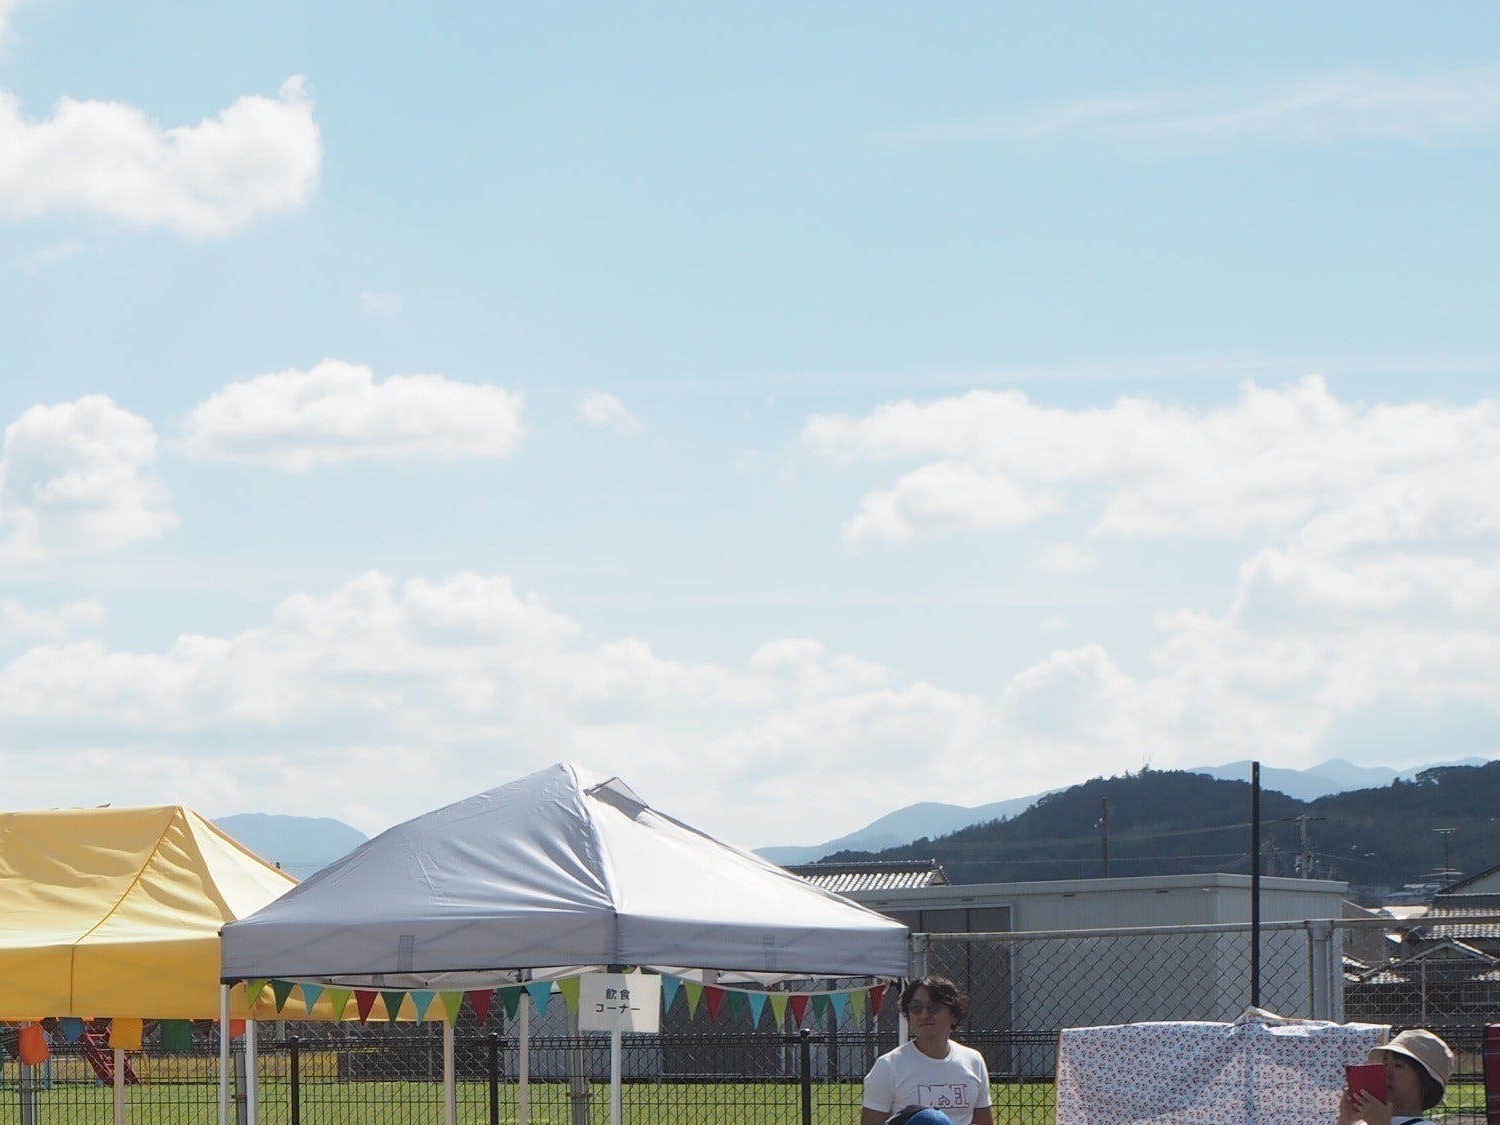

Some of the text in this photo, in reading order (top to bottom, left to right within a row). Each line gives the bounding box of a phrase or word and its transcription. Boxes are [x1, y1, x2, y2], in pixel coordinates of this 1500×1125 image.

[605, 988, 631, 1000] 飲食
[595, 1003, 641, 1014] コーナー
